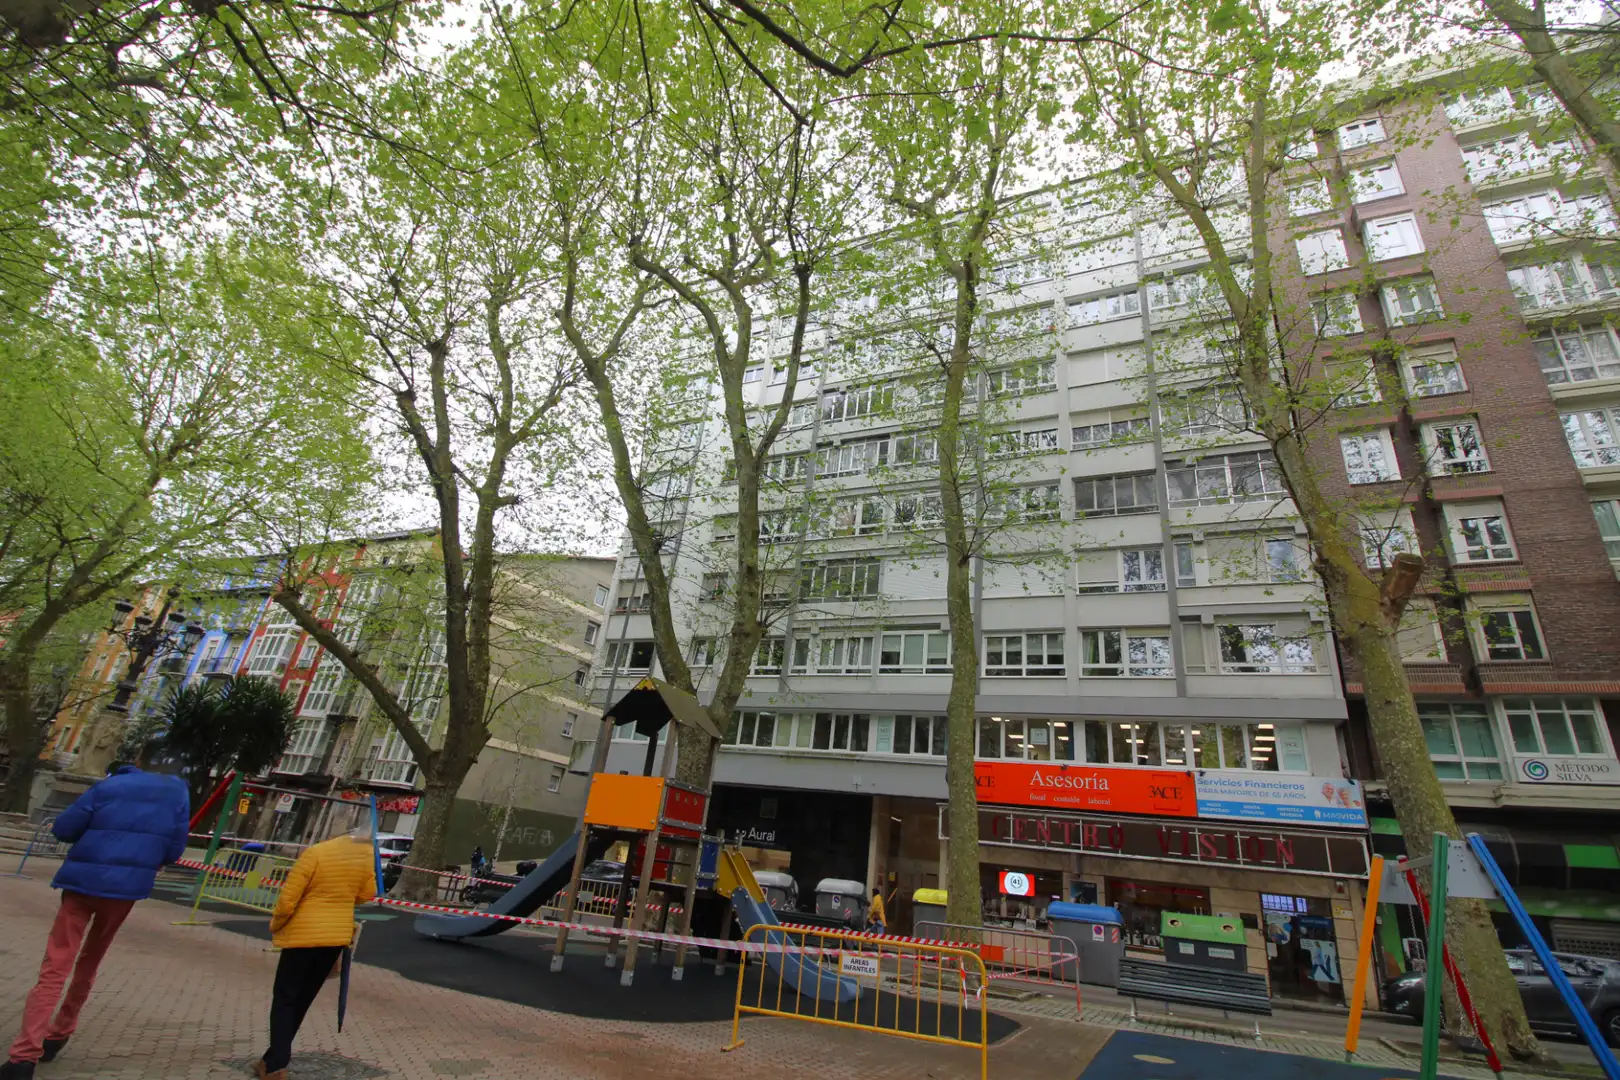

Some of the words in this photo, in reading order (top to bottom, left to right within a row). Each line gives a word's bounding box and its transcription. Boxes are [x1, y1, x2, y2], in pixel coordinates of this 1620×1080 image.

[1029, 769, 1110, 791] Asesoría
[1196, 777, 1243, 788] Servicios
[1244, 779, 1305, 791] Financieros
[1556, 773, 1593, 782] SILVA
[1029, 792, 1047, 801] fiscal
[1053, 795, 1081, 804] contable
[1087, 797, 1112, 806] laboral
[1198, 786, 1219, 794] PARA
[1220, 788, 1258, 798] MAYORES
[1259, 790, 1270, 798] DE
[747, 826, 776, 842] Aural
[992, 815, 1126, 850] CENTRO
[1156, 827, 1296, 866] VISION
[843, 963, 876, 974] INFANTILES
